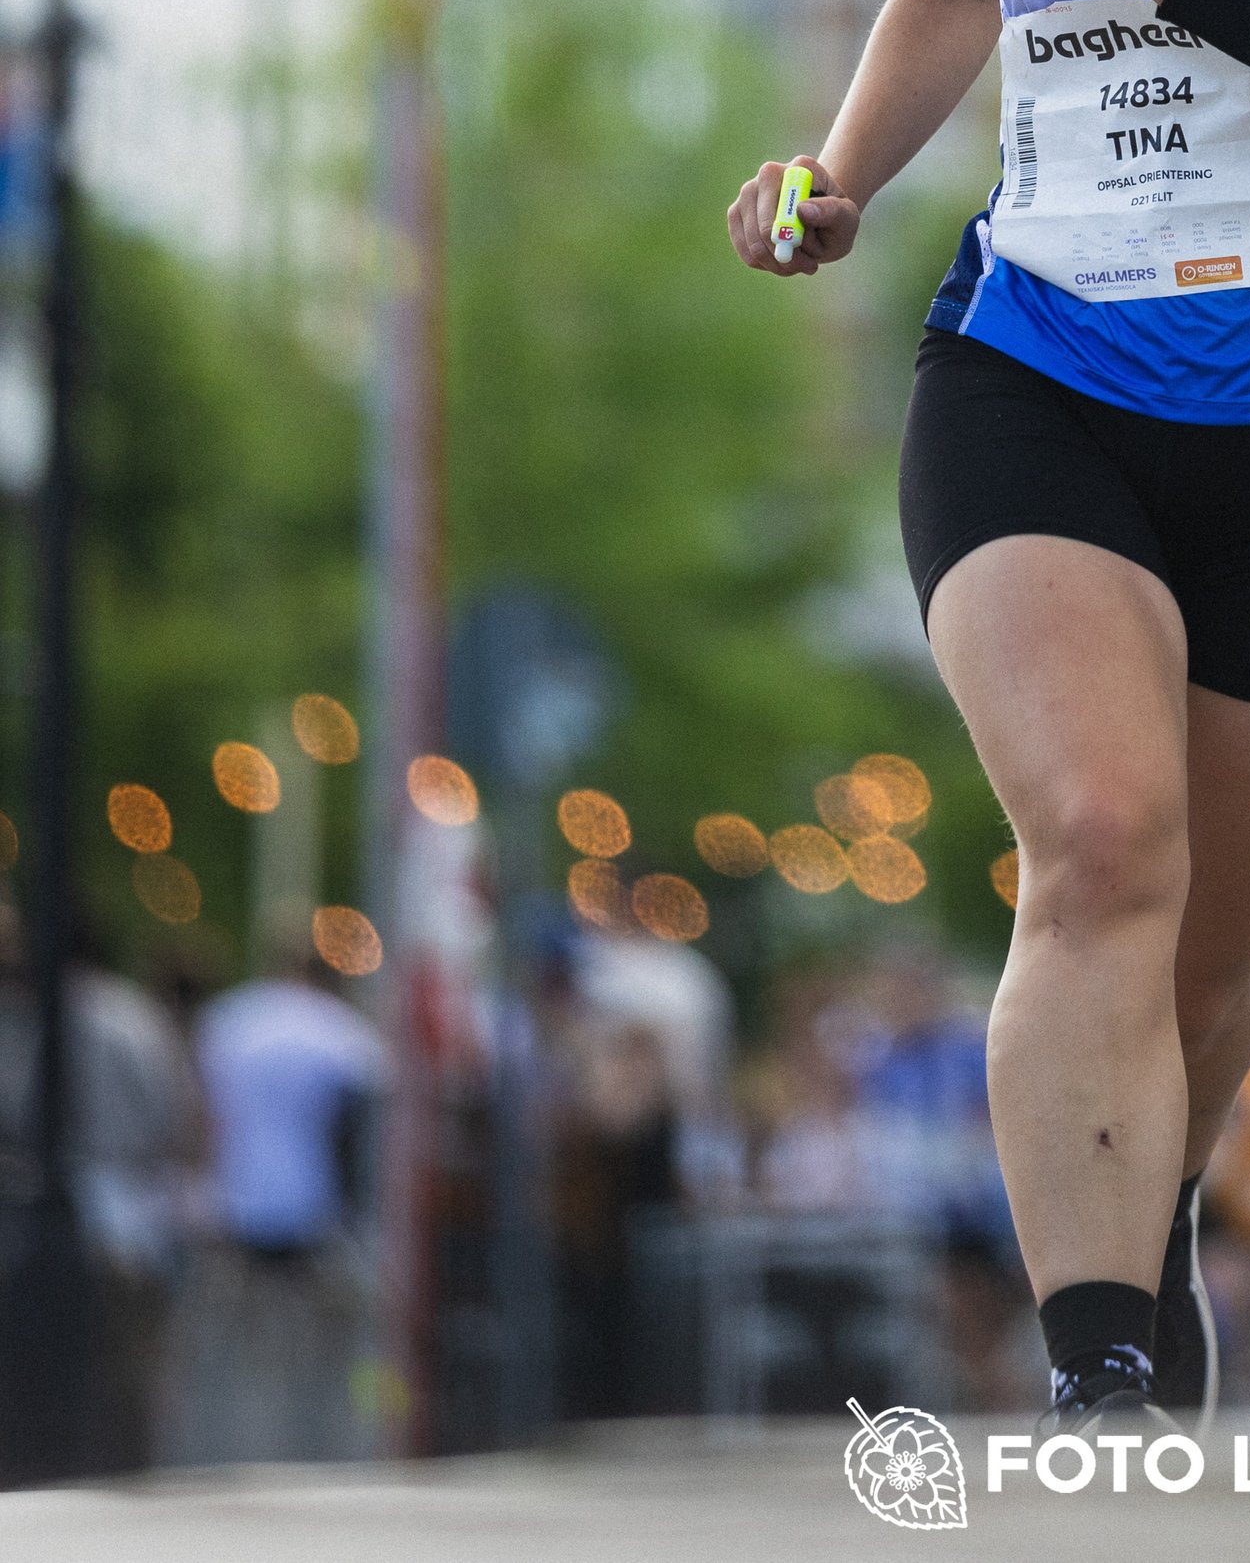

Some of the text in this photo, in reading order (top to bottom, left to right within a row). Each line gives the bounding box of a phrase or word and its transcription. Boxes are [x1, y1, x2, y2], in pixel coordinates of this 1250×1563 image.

[1099, 76, 1194, 111] 14834
[1106, 123, 1189, 161] TINA
[1097, 169, 1213, 192] OPPSAL ORIENTERING
[1131, 191, 1173, 207] D21 ELIT
[1075, 267, 1157, 286] CHALMERS
